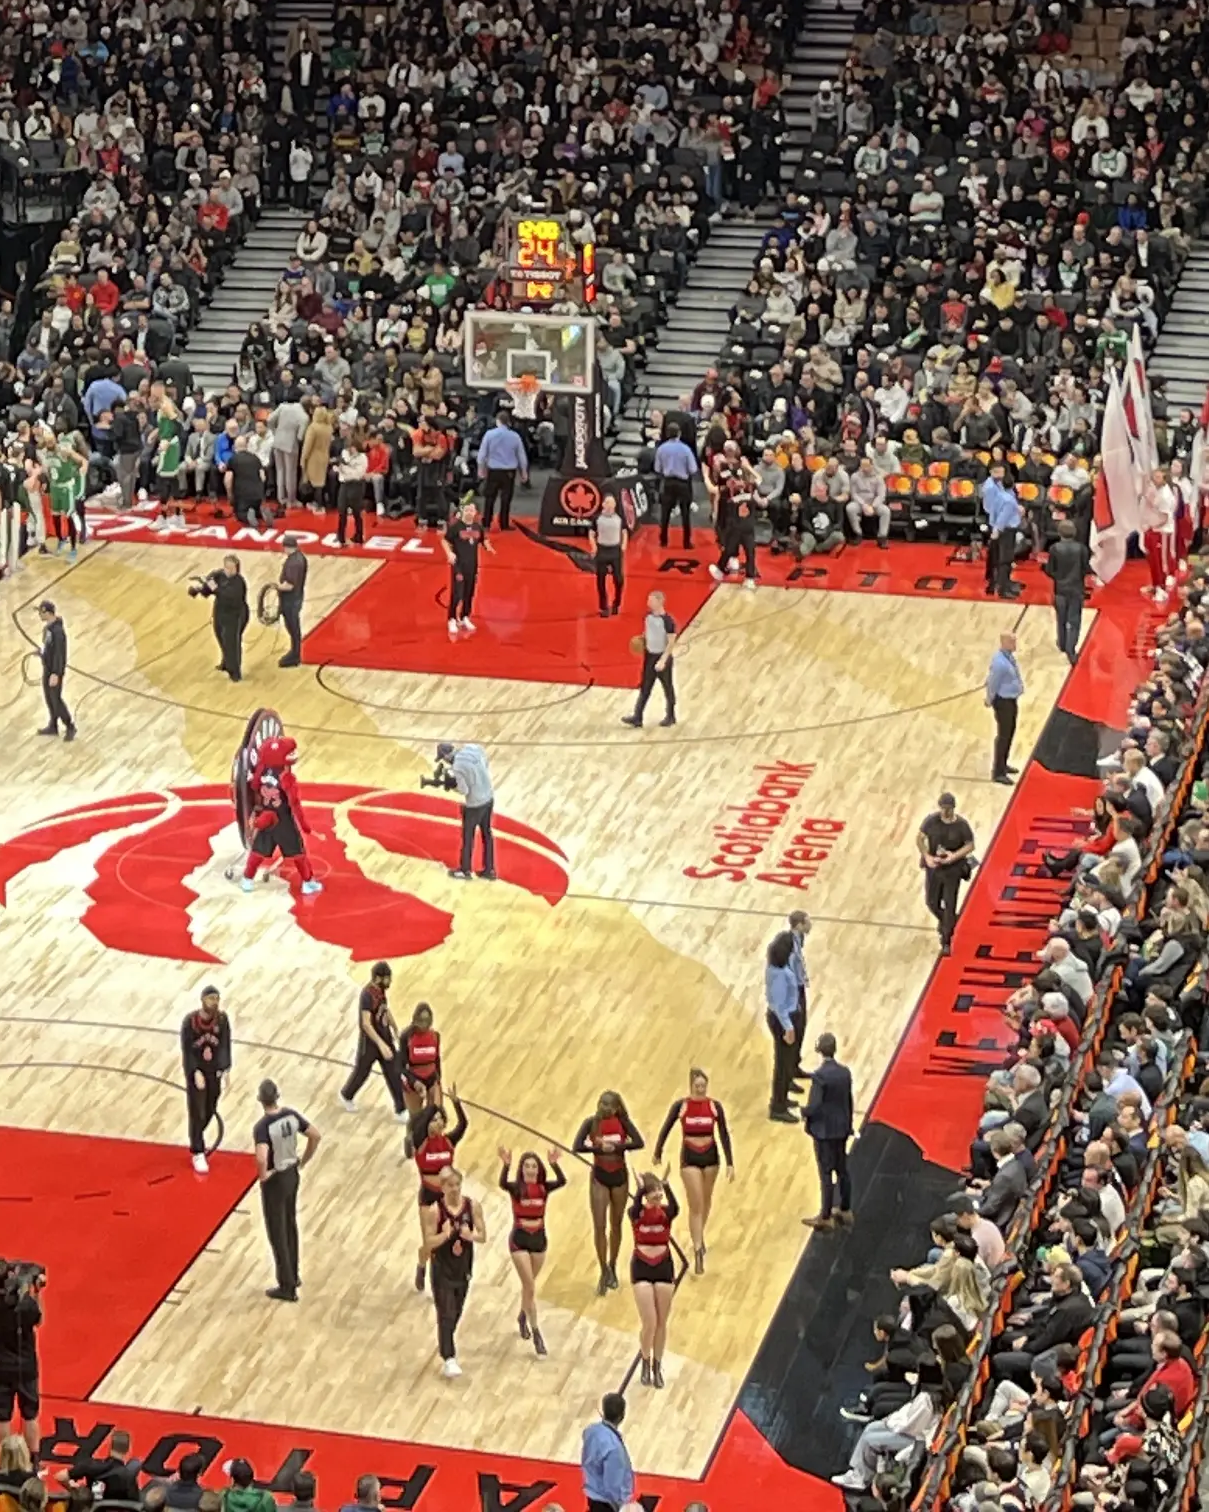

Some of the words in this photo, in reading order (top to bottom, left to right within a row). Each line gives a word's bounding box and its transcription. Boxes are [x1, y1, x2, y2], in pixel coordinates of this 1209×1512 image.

[517, 238, 555, 268] 24
[683, 759, 818, 883] Scotiabank
[754, 817, 848, 891] Arena
